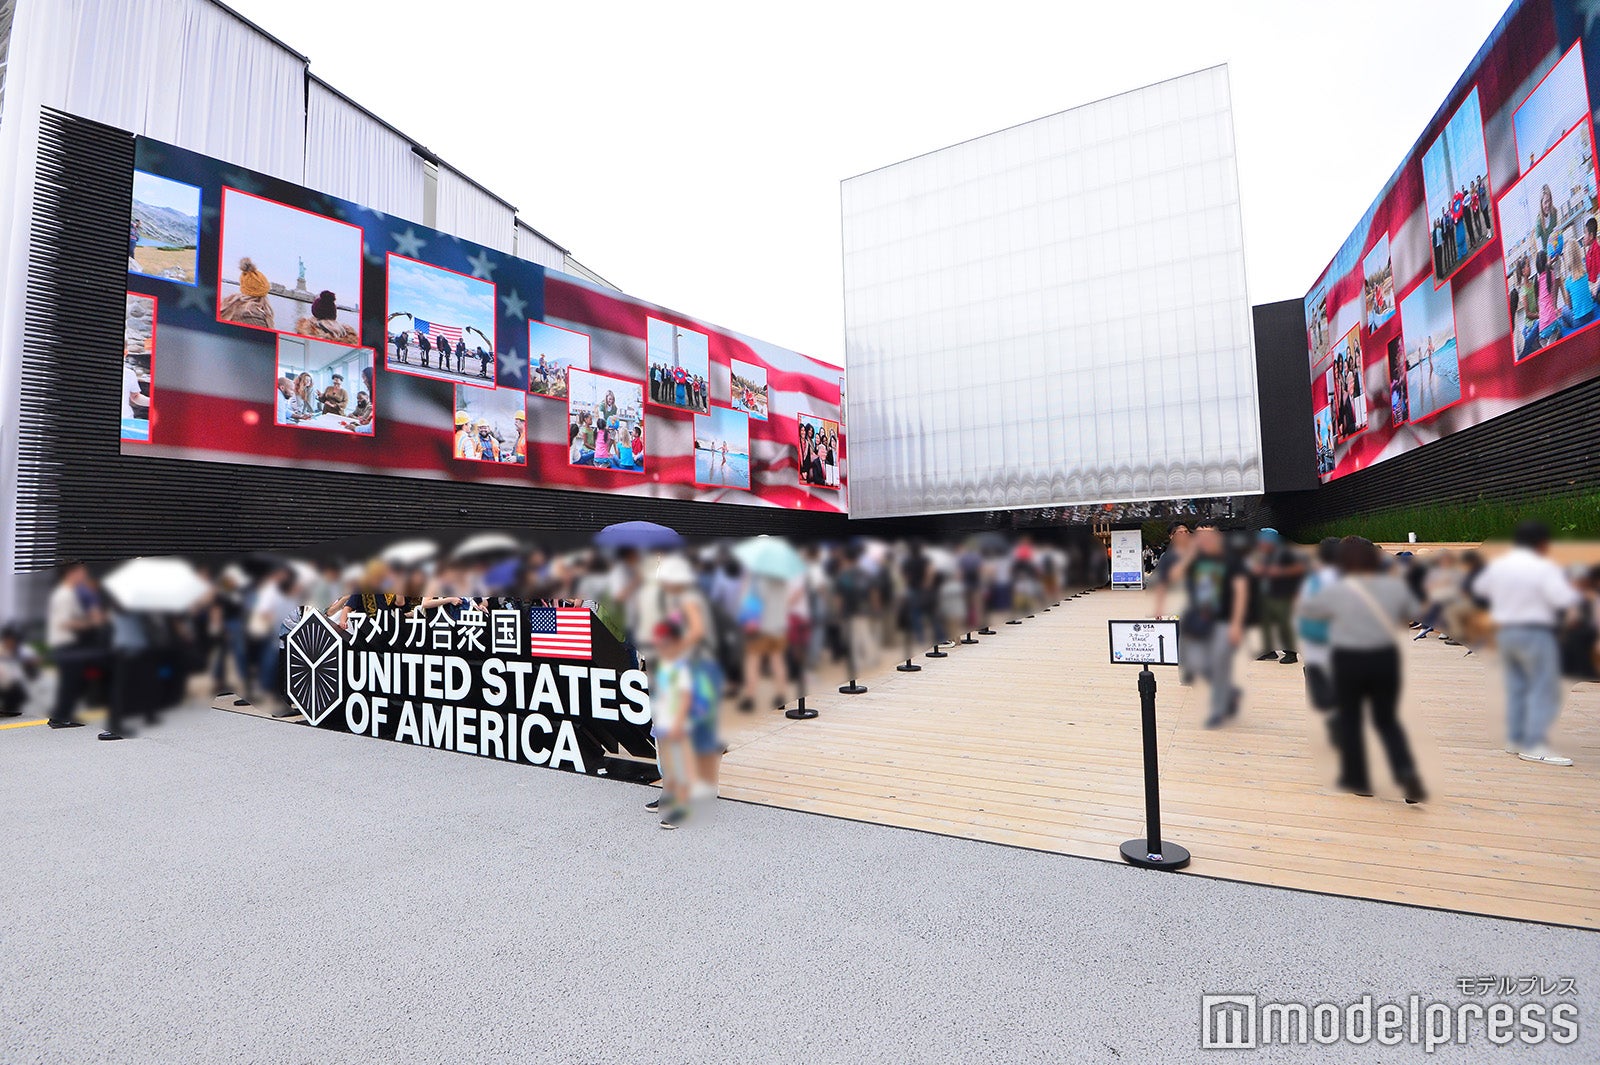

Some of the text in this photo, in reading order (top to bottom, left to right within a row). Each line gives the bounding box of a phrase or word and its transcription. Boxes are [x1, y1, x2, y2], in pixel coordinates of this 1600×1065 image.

[347, 605, 522, 655] アメリカ合衆国
[347, 650, 652, 726] UNITED STATES
[345, 693, 587, 773] OF AMERICA
